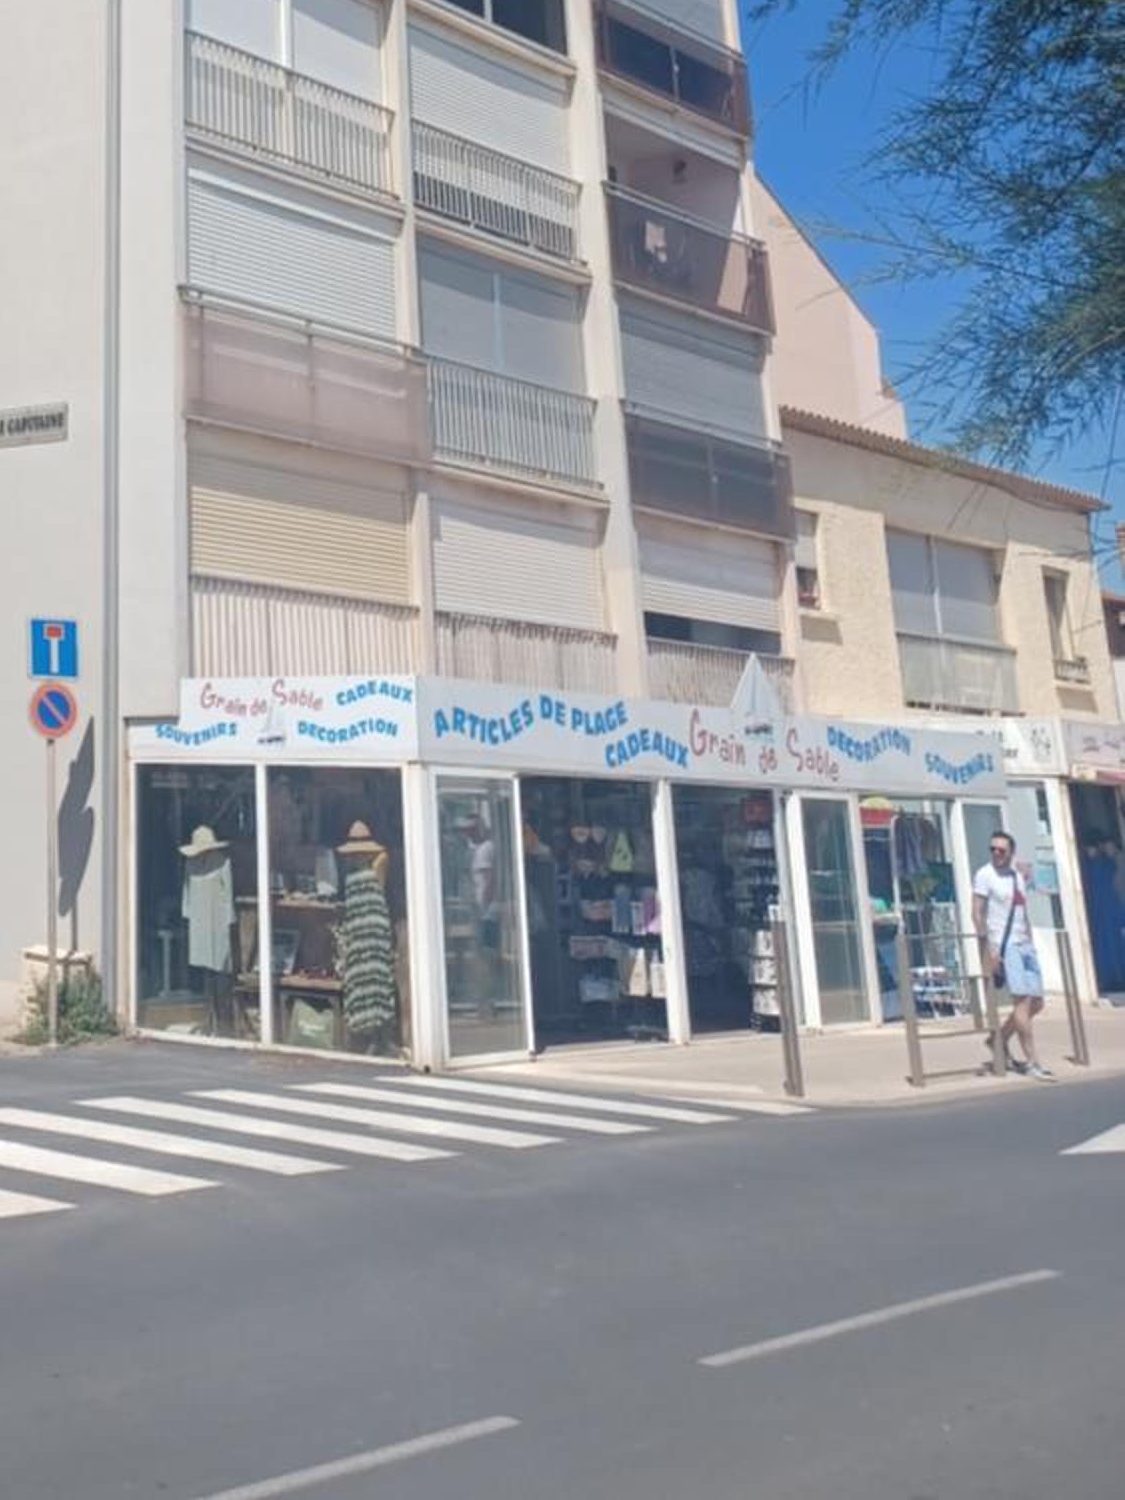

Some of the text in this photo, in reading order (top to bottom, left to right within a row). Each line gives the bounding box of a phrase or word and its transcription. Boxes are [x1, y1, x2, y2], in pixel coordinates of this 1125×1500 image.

[199, 678, 414, 716] Grain de Sable CADEAUX
[154, 717, 398, 747] SOUVENIRS DECORATION
[433, 694, 688, 768] ARTICLES DE PLAGE CADEAUX
[688, 707, 994, 786] Grain de Sable DECORATION SOUVENIRS
